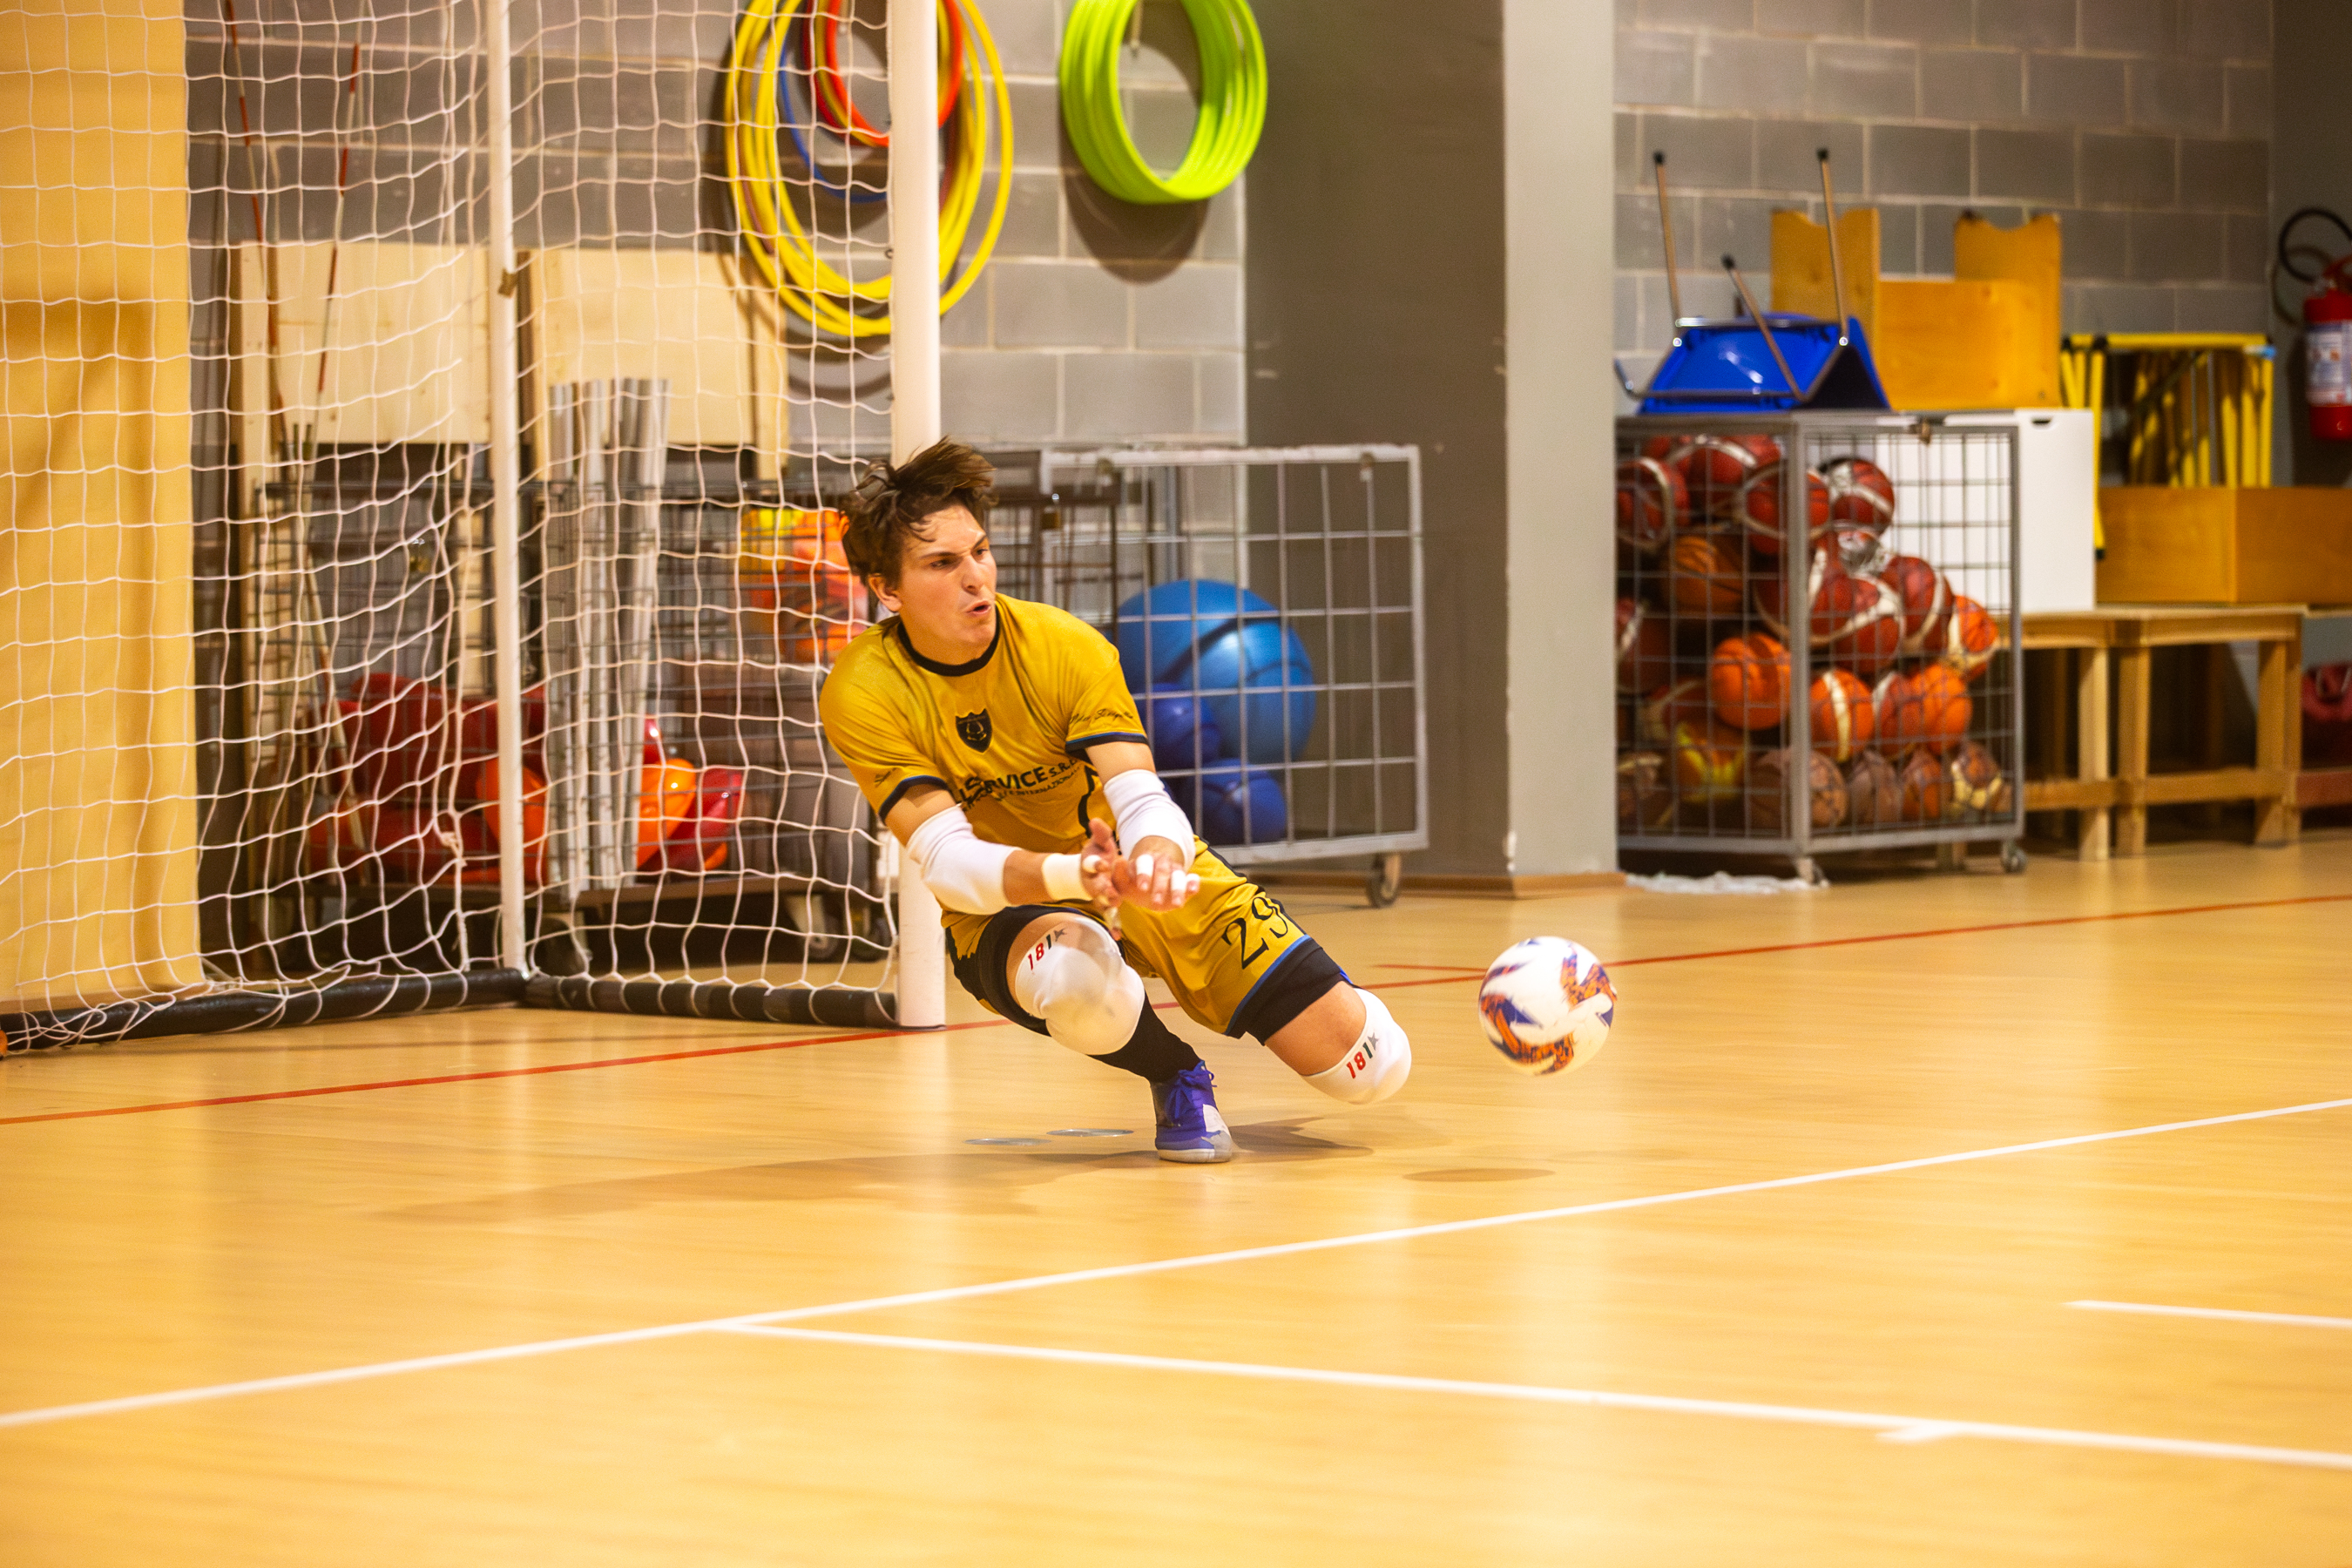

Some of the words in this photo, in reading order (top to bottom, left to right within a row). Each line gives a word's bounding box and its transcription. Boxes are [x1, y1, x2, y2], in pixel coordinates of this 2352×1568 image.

[1027, 933, 1052, 971] 181
[1221, 897, 1288, 970] 29
[1346, 1041, 1374, 1079] 181
